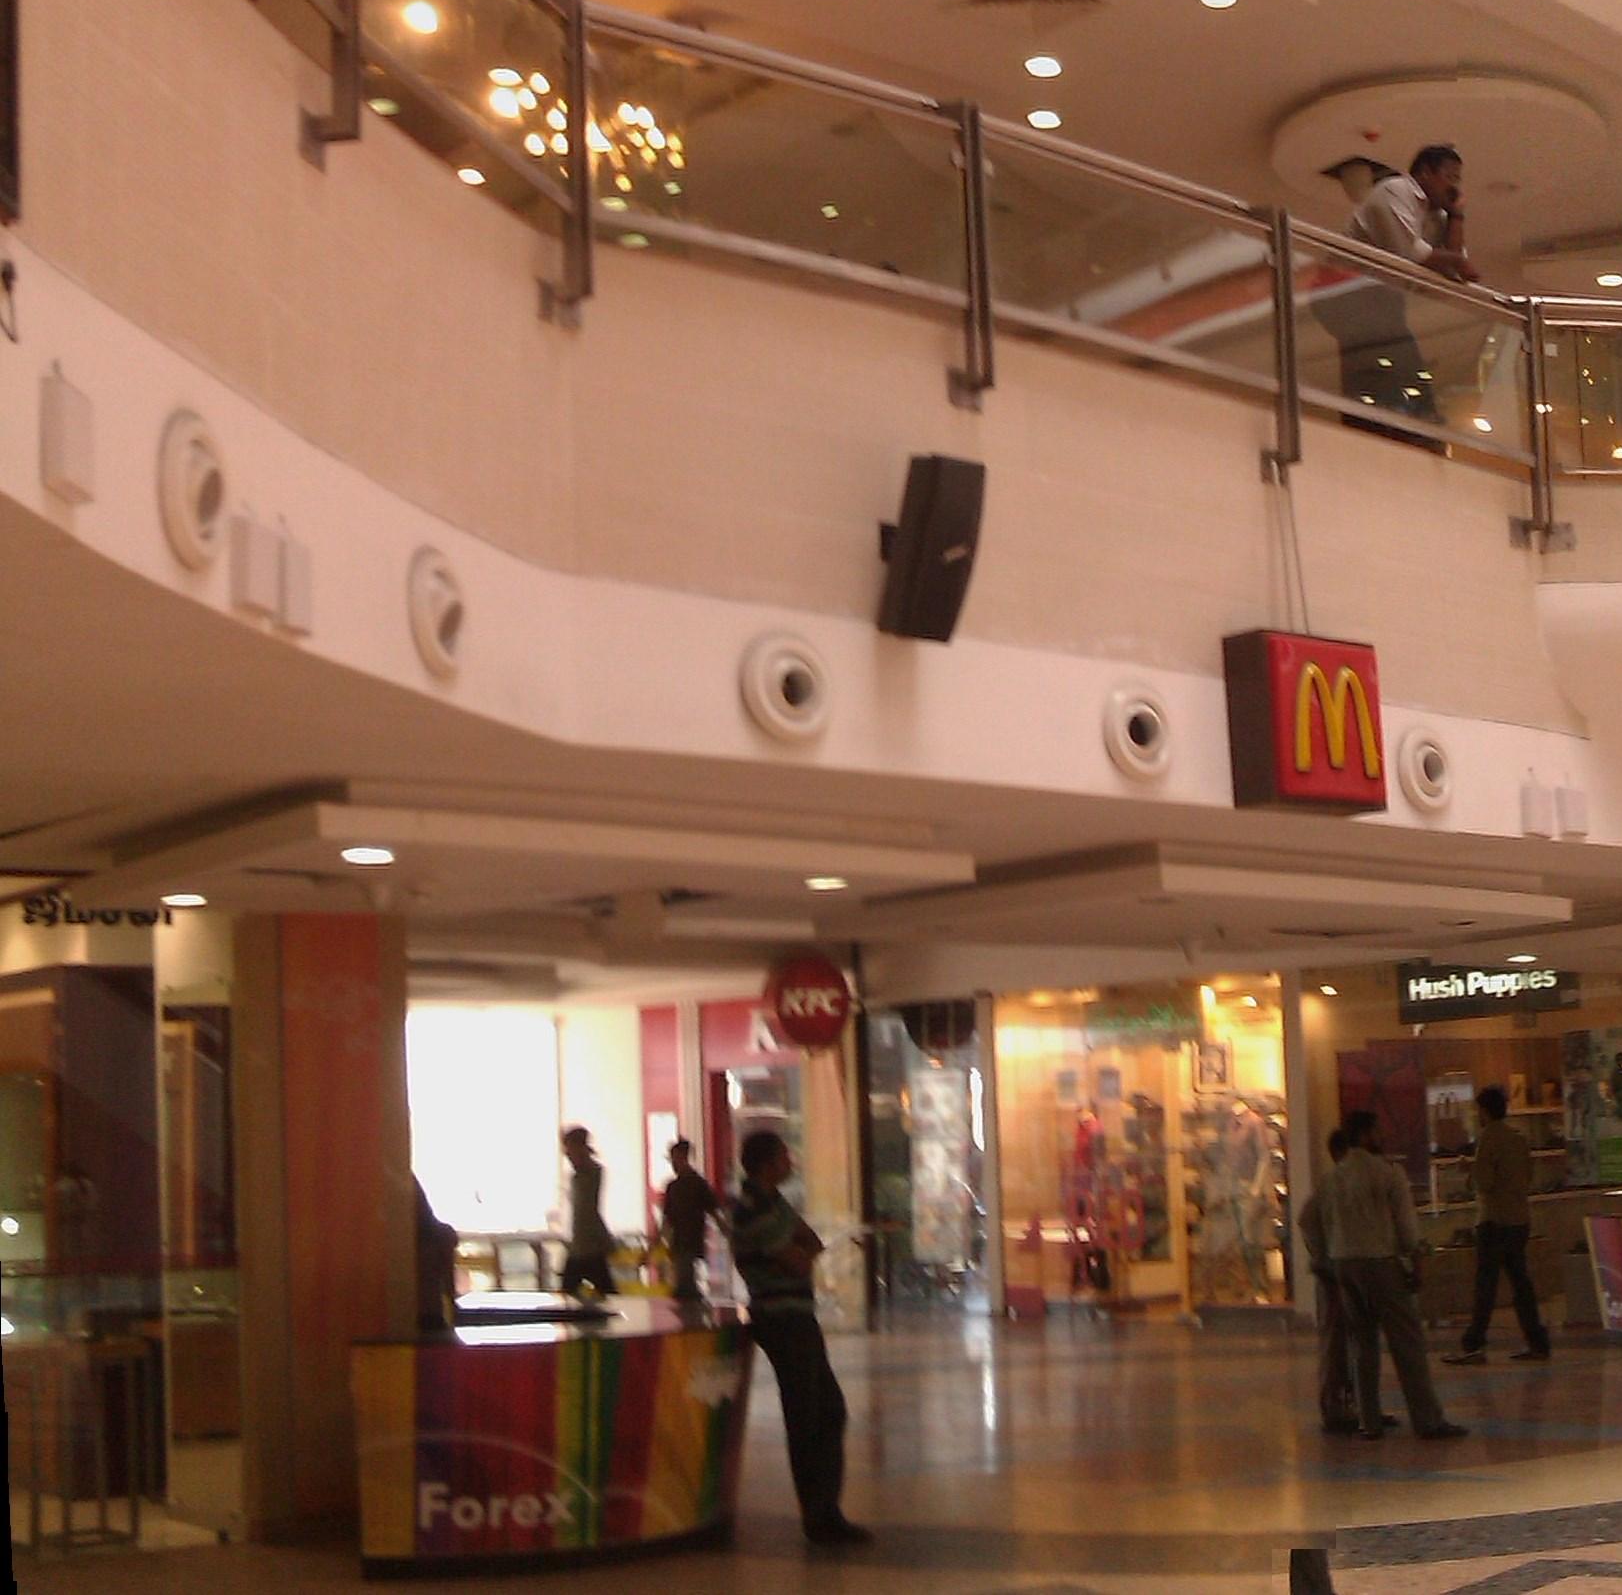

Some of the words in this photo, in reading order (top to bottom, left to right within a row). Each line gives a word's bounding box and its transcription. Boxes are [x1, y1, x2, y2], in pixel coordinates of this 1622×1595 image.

[1409, 976, 1466, 1002] Hush
[1467, 969, 1557, 997] Puppies
[419, 1480, 576, 1531] Forex
